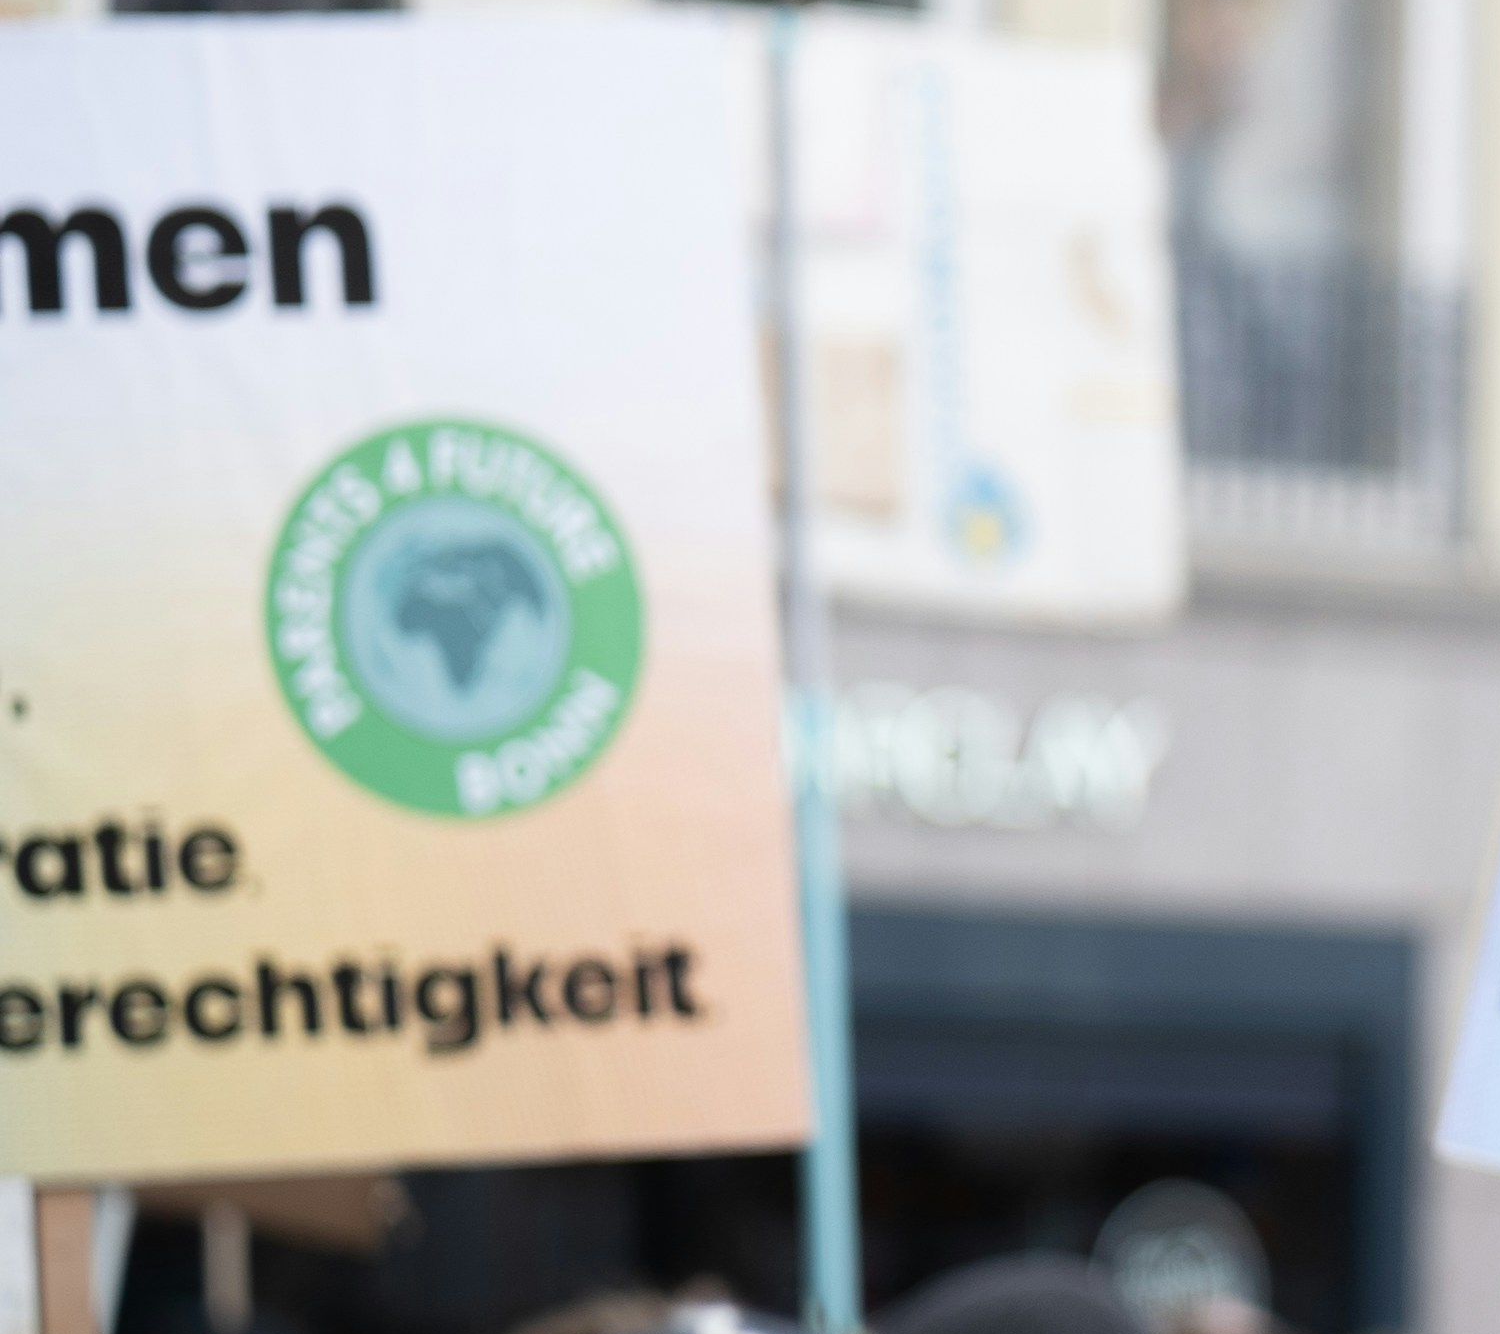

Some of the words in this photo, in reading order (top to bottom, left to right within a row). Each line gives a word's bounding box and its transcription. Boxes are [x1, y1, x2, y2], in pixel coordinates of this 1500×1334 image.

[274, 462, 382, 742] PARENTS
[381, 435, 424, 497] 4
[425, 425, 620, 583] FUTURE
[453, 667, 622, 817] BONN
[0, 802, 240, 907] atie
